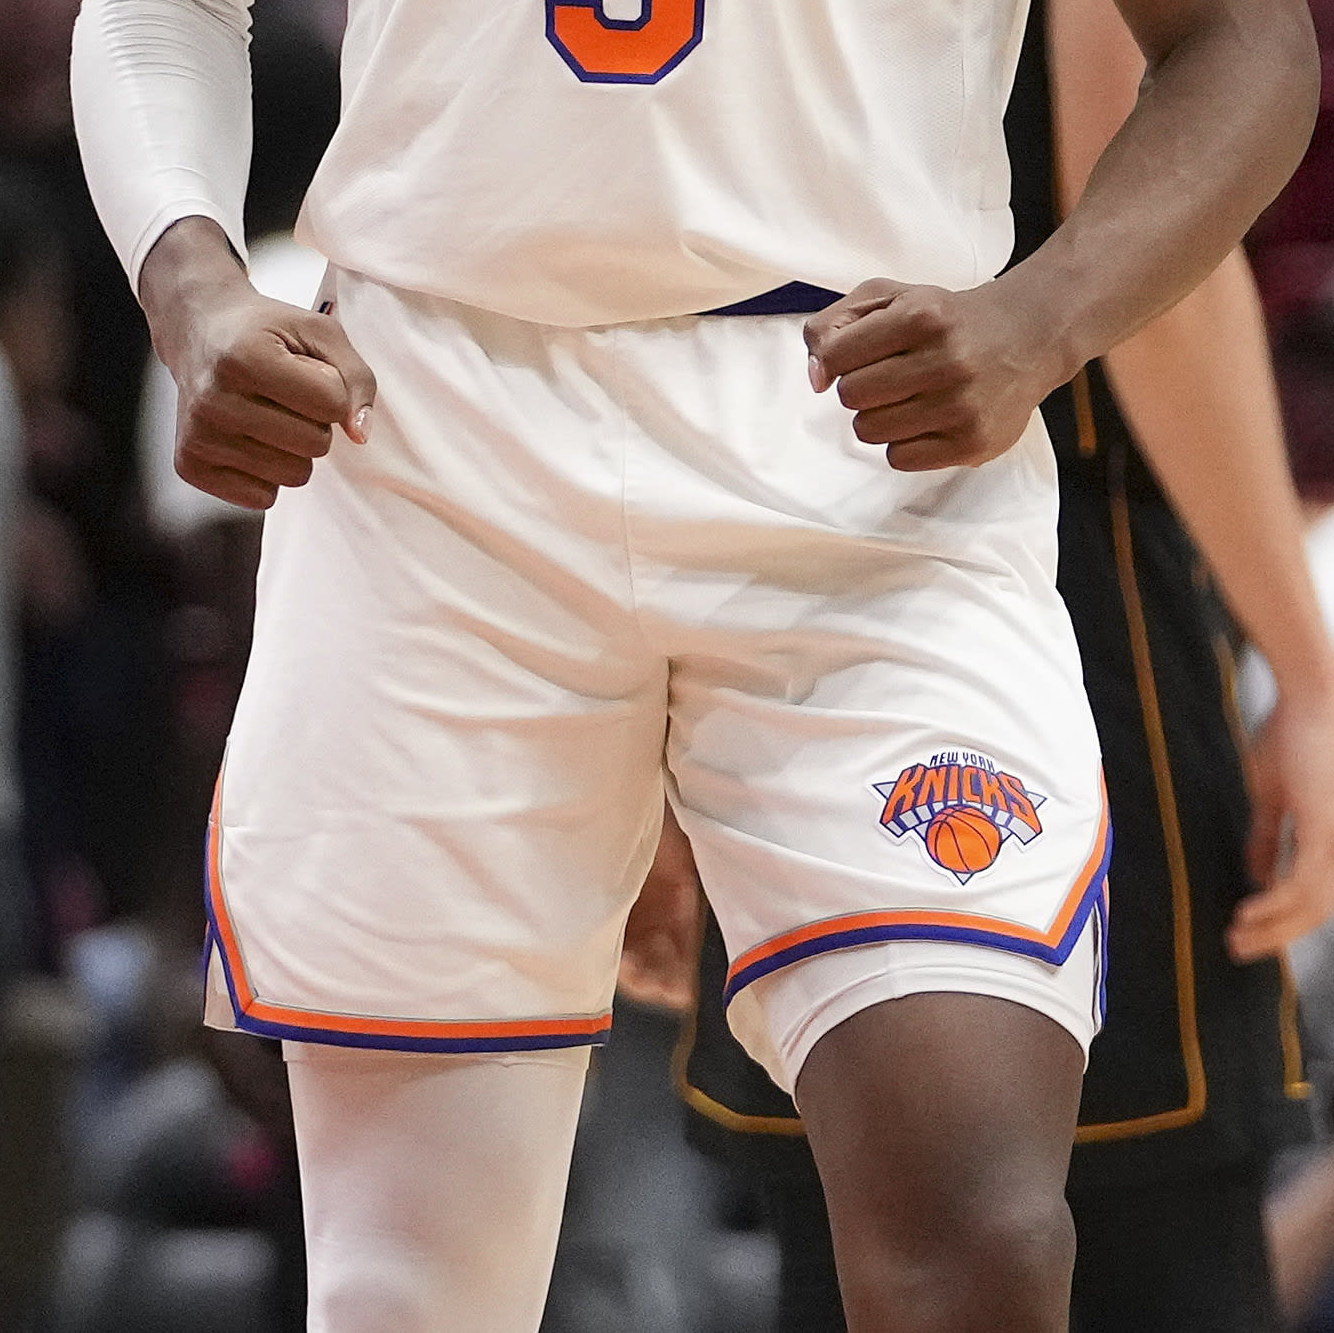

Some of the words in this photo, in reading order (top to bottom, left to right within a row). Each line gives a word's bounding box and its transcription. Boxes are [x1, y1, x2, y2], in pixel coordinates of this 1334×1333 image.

[929, 752, 959, 767] NEW
[962, 753, 995, 773] YORK
[879, 763, 1043, 838] KNICKS
